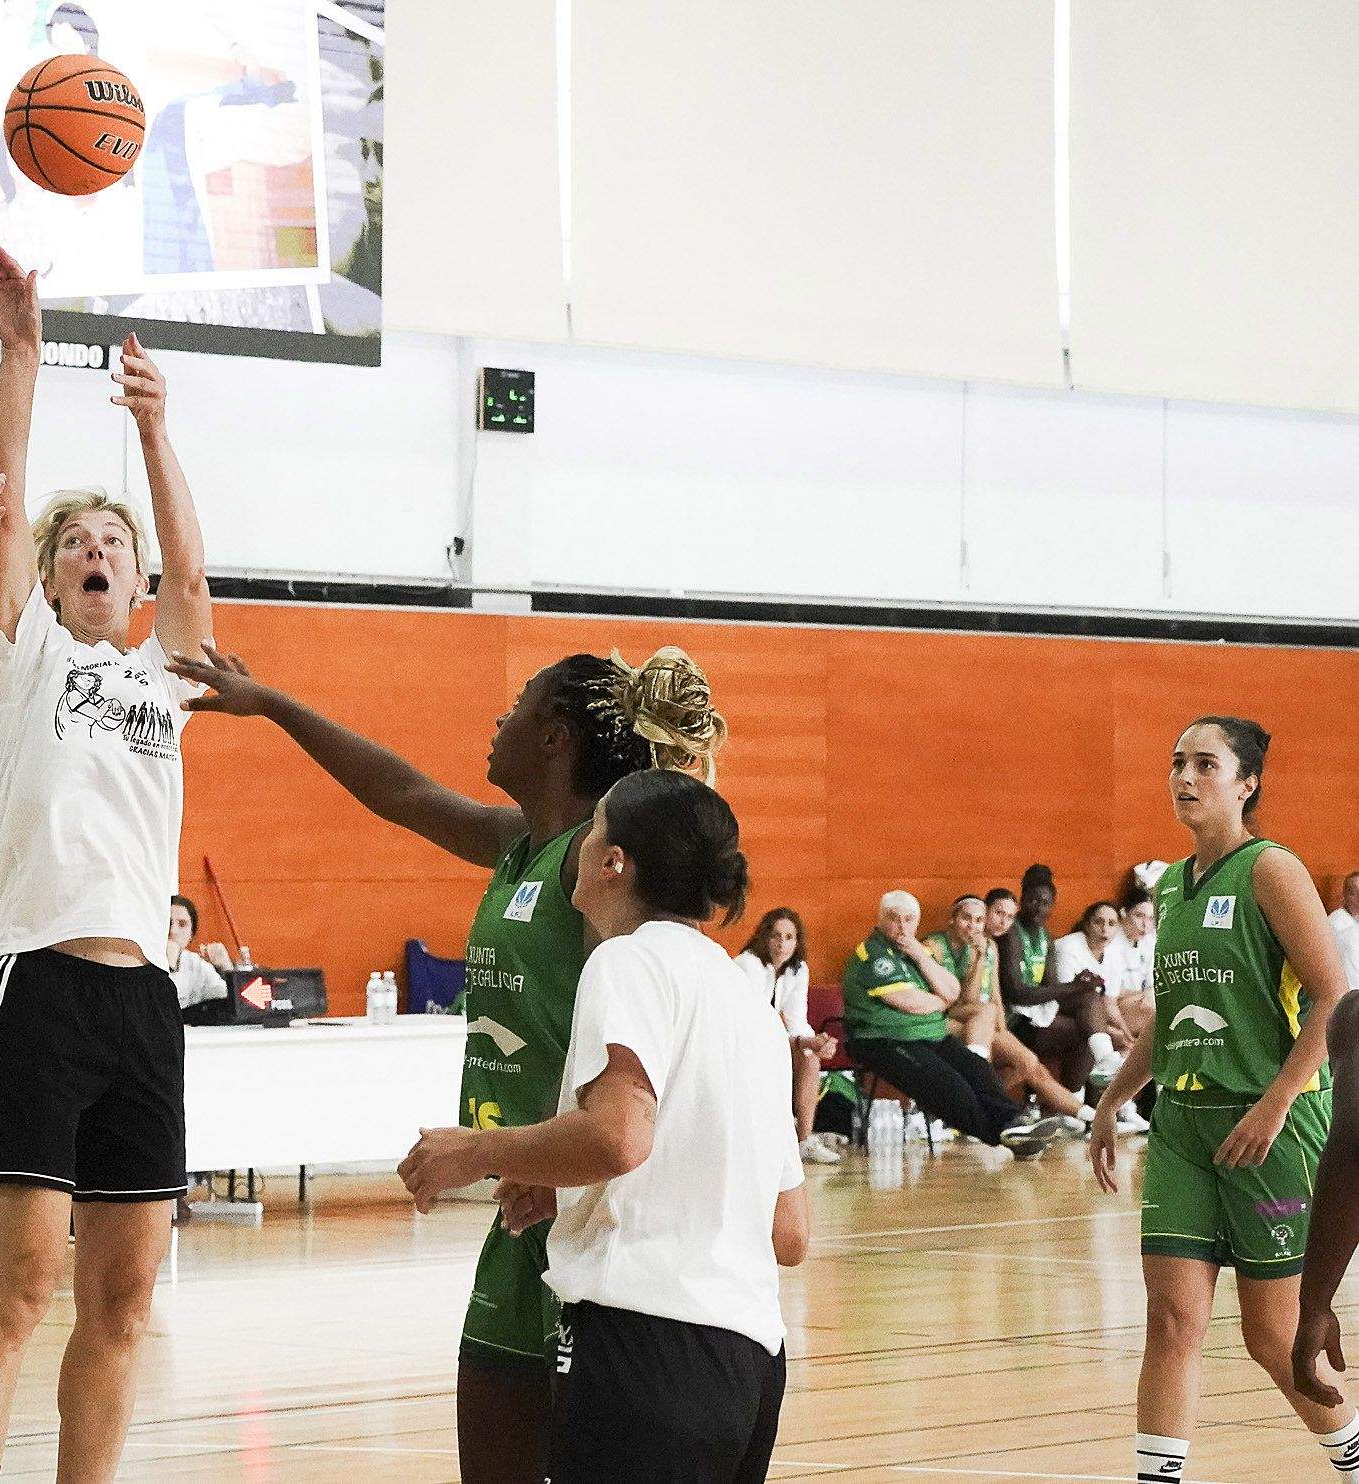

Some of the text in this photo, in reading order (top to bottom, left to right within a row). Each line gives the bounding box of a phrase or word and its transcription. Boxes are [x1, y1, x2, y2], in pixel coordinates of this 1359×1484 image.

[40, 340, 104, 369] ONDO
[1163, 950, 1199, 968] XUNTA
[477, 969, 525, 993] GALICIA
